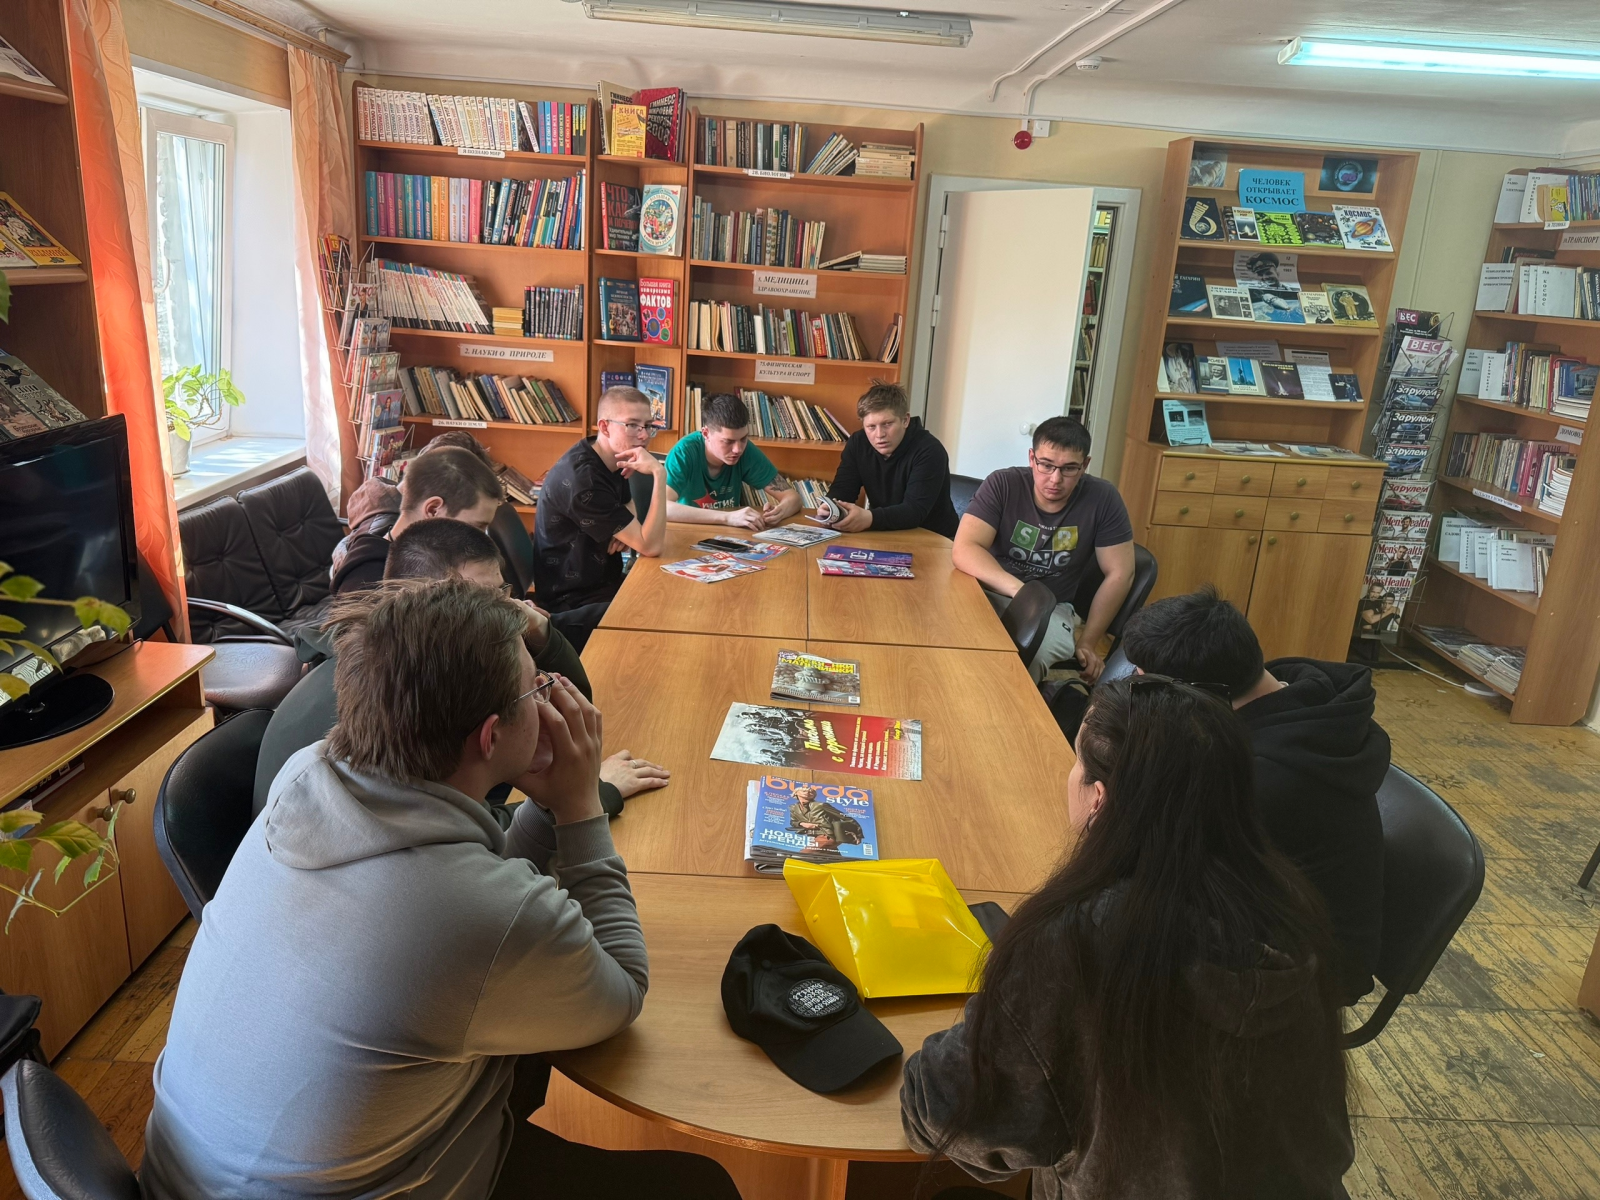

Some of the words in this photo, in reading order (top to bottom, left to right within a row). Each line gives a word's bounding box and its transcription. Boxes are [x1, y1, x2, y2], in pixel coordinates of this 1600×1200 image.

[650, 94, 676, 108] ГИННЕСС
[646, 122, 670, 146] 2008
[1252, 178, 1291, 186] ЧЕЛОВЕК
[607, 184, 628, 202] ЧТО
[1246, 186, 1296, 196] ОТКРЫВАЕТ
[1245, 196, 1300, 206] КОСМОС
[608, 200, 629, 218] КАК
[1344, 210, 1372, 218] КОСМОС
[763, 275, 809, 286] МЕДИЦИНА
[758, 286, 811, 296] ЗДРАВООХРАНЕНИЕ
[640, 294, 672, 308] ФАКТОВ
[1410, 340, 1441, 352] ВЕС
[472, 348, 498, 356] НАУКИ
[510, 350, 548, 359] ПРИРОДЕ
[1408, 387, 1438, 396] рулем
[1392, 412, 1405, 421] За
[1405, 414, 1434, 423] рулем
[1397, 448, 1428, 456] рулем
[1538, 444, 1562, 452] КУХНЯ
[1387, 484, 1398, 492] За
[1398, 485, 1428, 494] рулем
[1409, 518, 1430, 528] ealth
[1384, 576, 1411, 588] Health
[804, 719, 823, 751] Письма
[820, 720, 848, 754] фронта
[766, 776, 869, 801] burda
[826, 796, 870, 806] style
[760, 832, 819, 848] ТРЕНДЫ
[764, 828, 816, 842] НОВЫЕ
